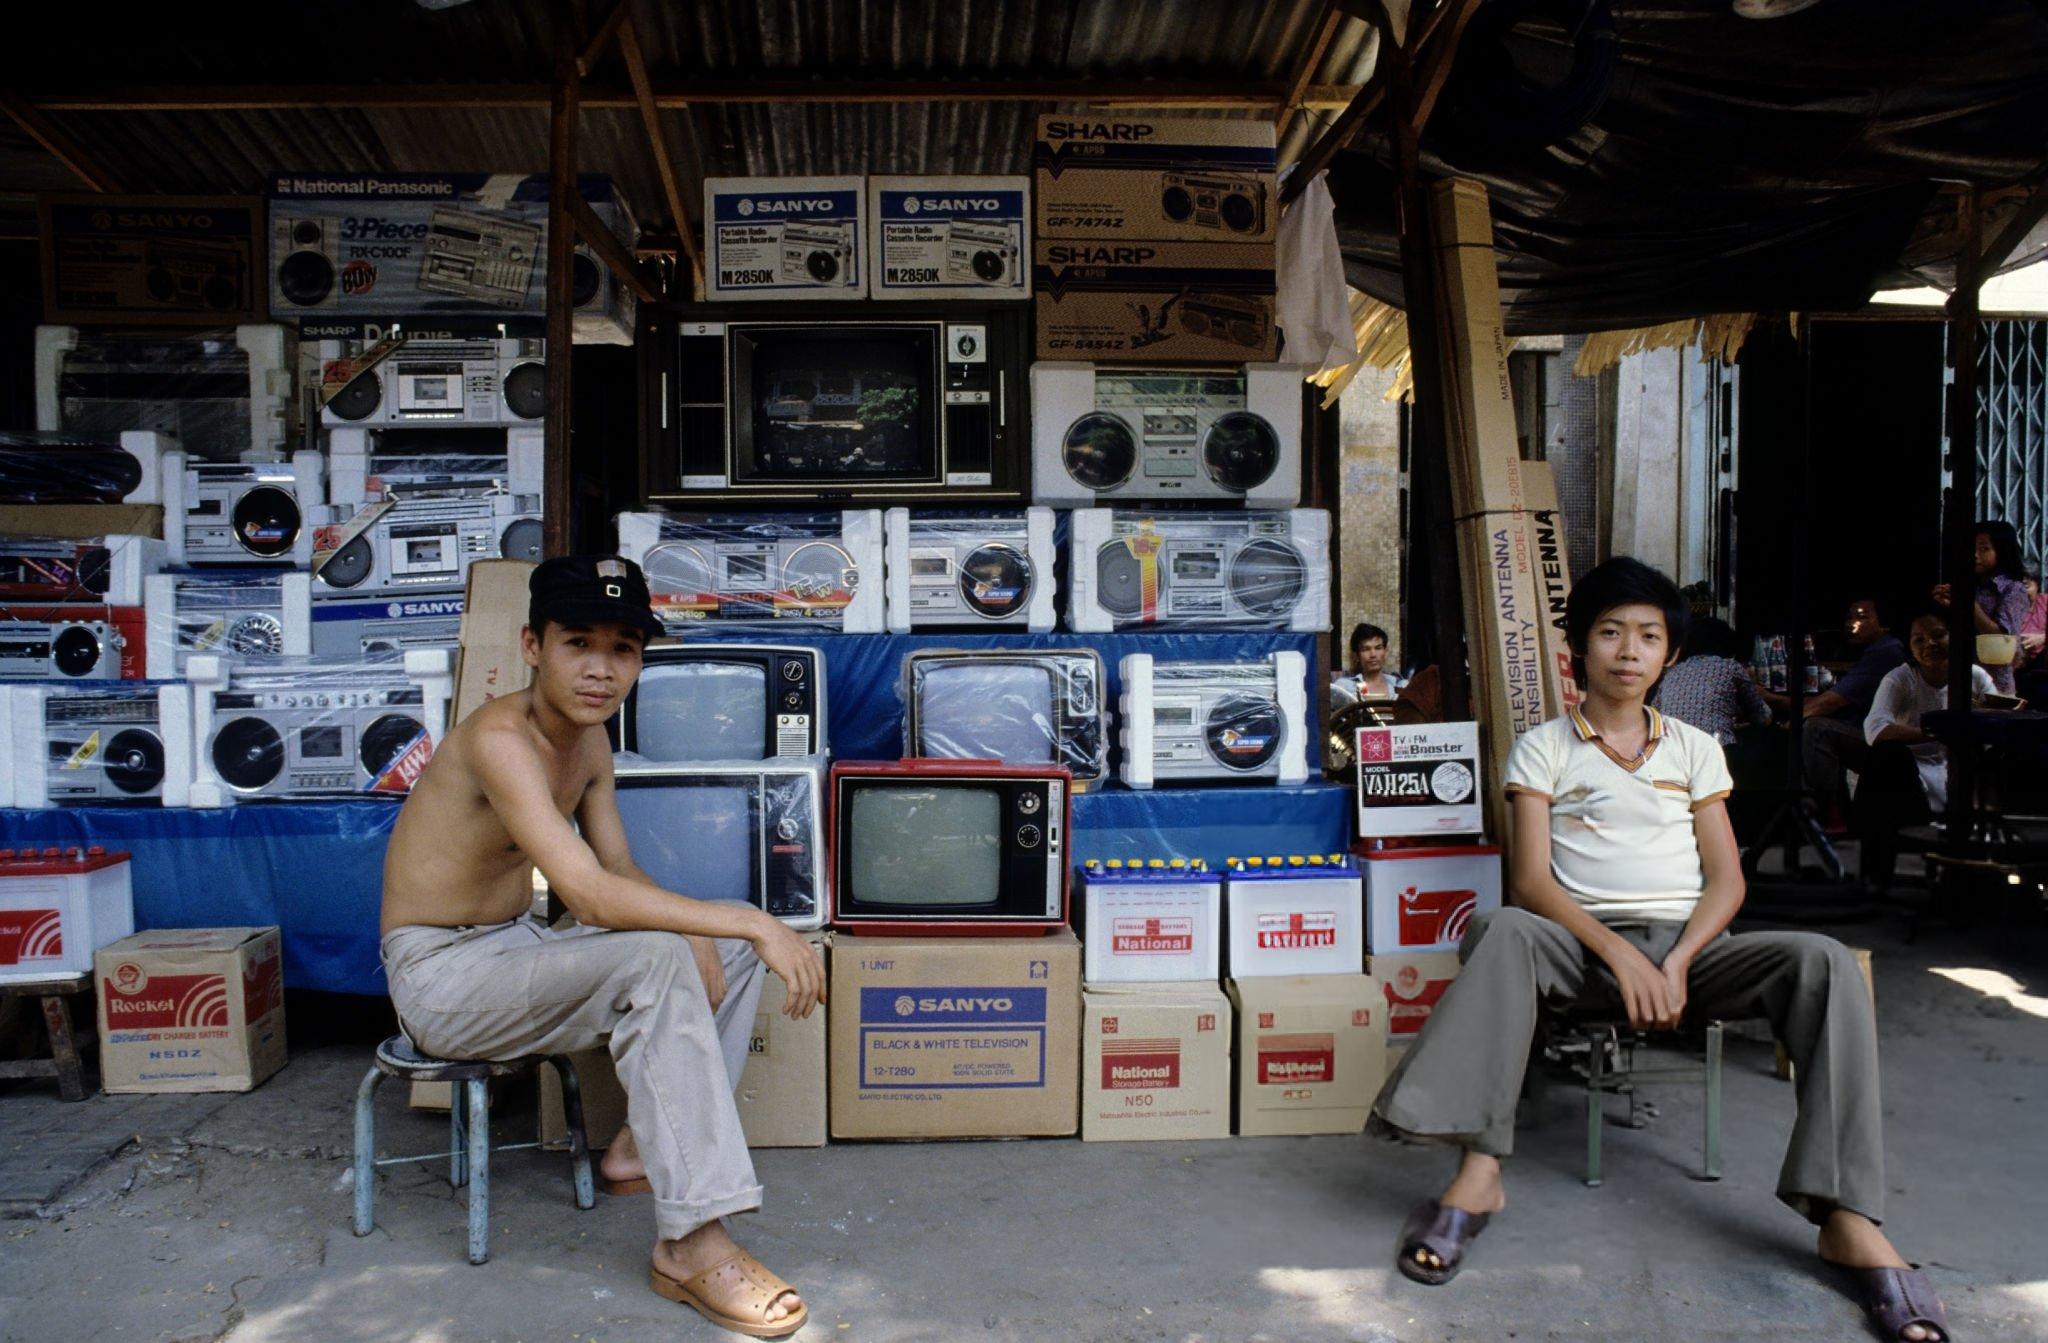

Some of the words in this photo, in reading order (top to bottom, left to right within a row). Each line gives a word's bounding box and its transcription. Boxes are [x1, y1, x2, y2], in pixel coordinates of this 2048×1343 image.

[1046, 121, 1154, 140] SHARP
[293, 179, 364, 194] National
[367, 180, 453, 194] Panasonic
[756, 200, 834, 212] SANYO
[923, 199, 1000, 211] SANYO
[117, 214, 213, 228] SANYO
[341, 217, 429, 240] 3-Piece
[886, 226, 913, 234] Portable
[750, 236, 778, 244] Recorder
[915, 234, 944, 242] Recorder
[1048, 246, 1155, 264] SHARP
[303, 326, 356, 336] SHARP
[1493, 326, 1505, 358] JAPAN
[1498, 361, 1507, 372] IN
[1500, 373, 1511, 400] MADE
[1514, 525, 1529, 574] MODEL
[1494, 528, 1517, 622] ANTENNA
[1535, 509, 1569, 631] ANTENNA
[487, 667, 498, 685] TV
[1520, 620, 1542, 732] ENSIBILITY
[1393, 736, 1407, 744] TV
[1413, 735, 1427, 743] FM
[1410, 744, 1464, 755] Booster
[1118, 936, 1187, 950] National
[861, 961, 867, 970] 1
[869, 960, 895, 970] UNIT
[111, 998, 175, 1013] Rocket
[918, 998, 1013, 1011] SANYO
[163, 1031, 196, 1040] CHARGED
[873, 1039, 911, 1049] BLACK
[913, 1040, 921, 1048] &
[923, 1039, 960, 1049] WHITE
[963, 1038, 1029, 1048] TELEVISION
[873, 1066, 916, 1076] 12-T280
[1112, 1066, 1170, 1079] National
[1125, 1095, 1153, 1107] N50
